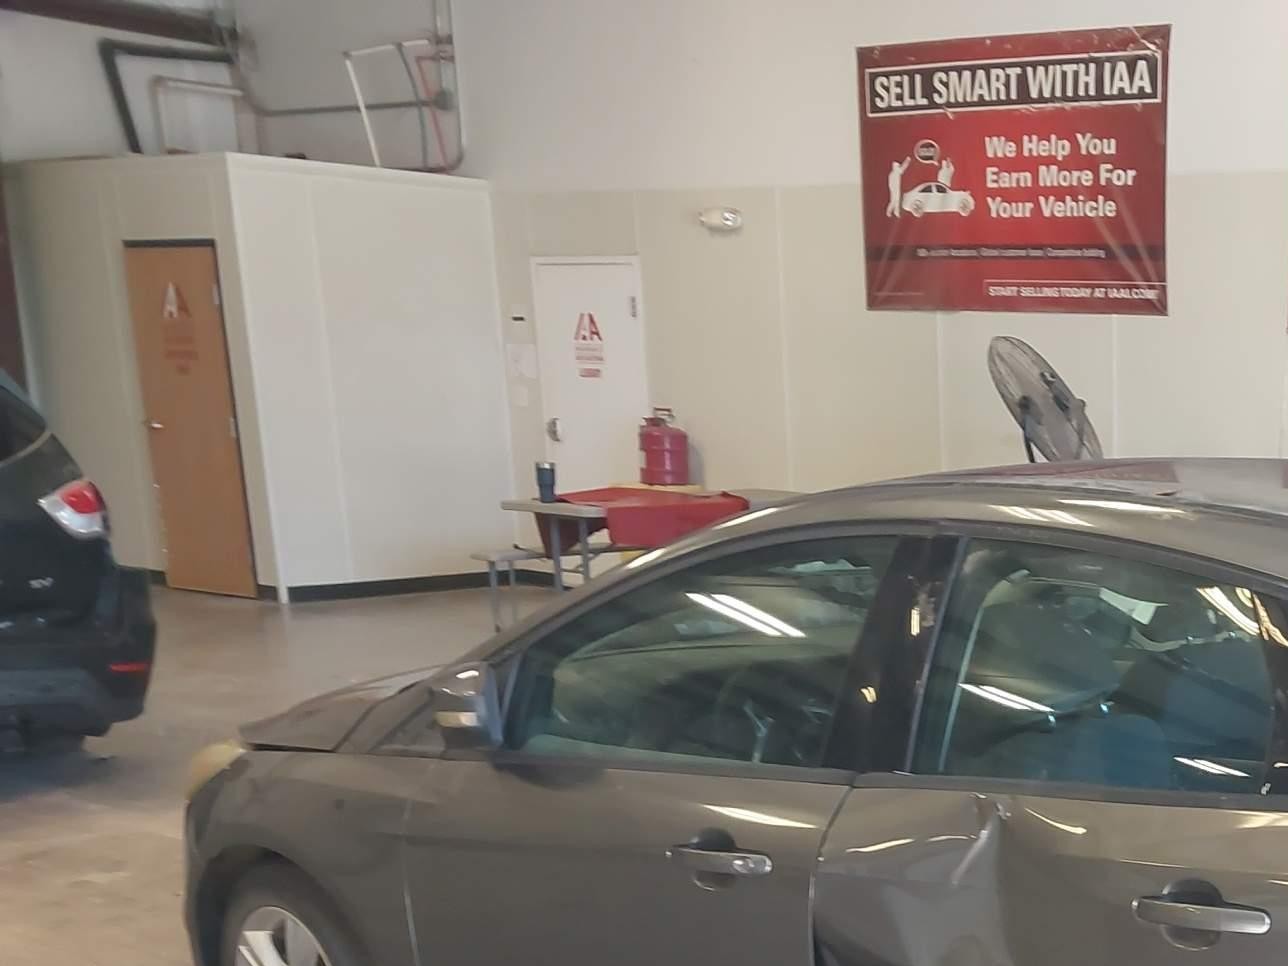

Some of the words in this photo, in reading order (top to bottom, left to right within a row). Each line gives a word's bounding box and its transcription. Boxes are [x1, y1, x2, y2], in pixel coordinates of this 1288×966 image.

[874, 73, 929, 109] SELL
[932, 67, 1022, 104] SMART
[1026, 62, 1096, 98] WITH
[1103, 59, 1153, 95] IAA
[984, 135, 1017, 158] We
[1022, 133, 1071, 161] Help
[1075, 132, 1116, 155] You
[985, 166, 1033, 188] Earn
[1038, 164, 1094, 187] More
[1099, 163, 1137, 186] For
[986, 196, 1034, 218] Your
[1038, 194, 1117, 218] Vehicle
